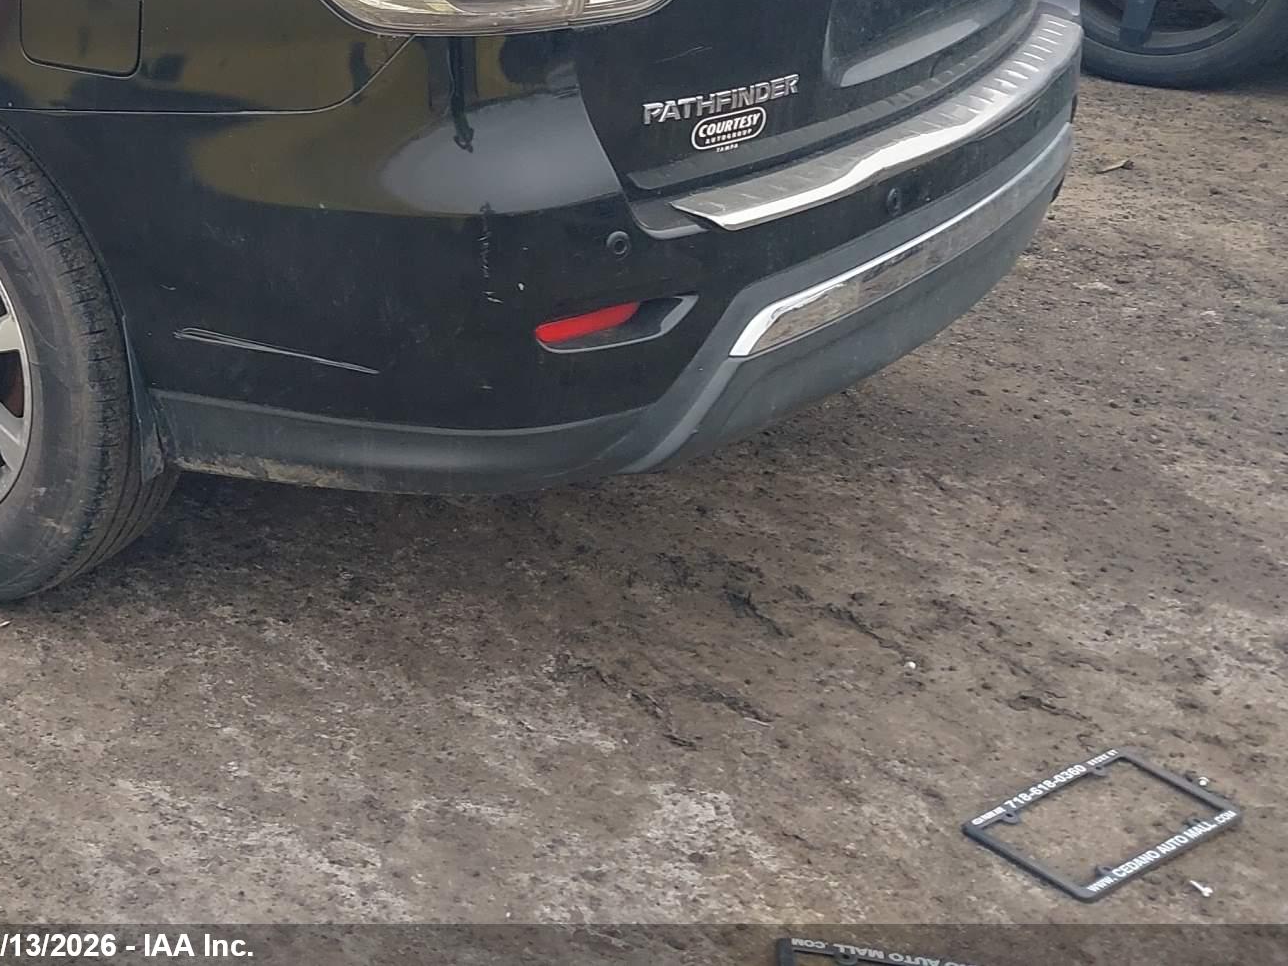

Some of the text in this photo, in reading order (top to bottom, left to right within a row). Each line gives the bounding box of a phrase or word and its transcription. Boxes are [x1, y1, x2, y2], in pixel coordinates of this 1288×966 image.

[642, 73, 800, 125] PATHFINDER
[698, 112, 761, 138] COURTESY
[1004, 764, 1088, 809] 718-618-0360
[1112, 850, 1161, 878] CEDANO
[1156, 835, 1189, 854] AUTO
[1183, 820, 1217, 840] MALL
[833, 943, 884, 959] MALL
